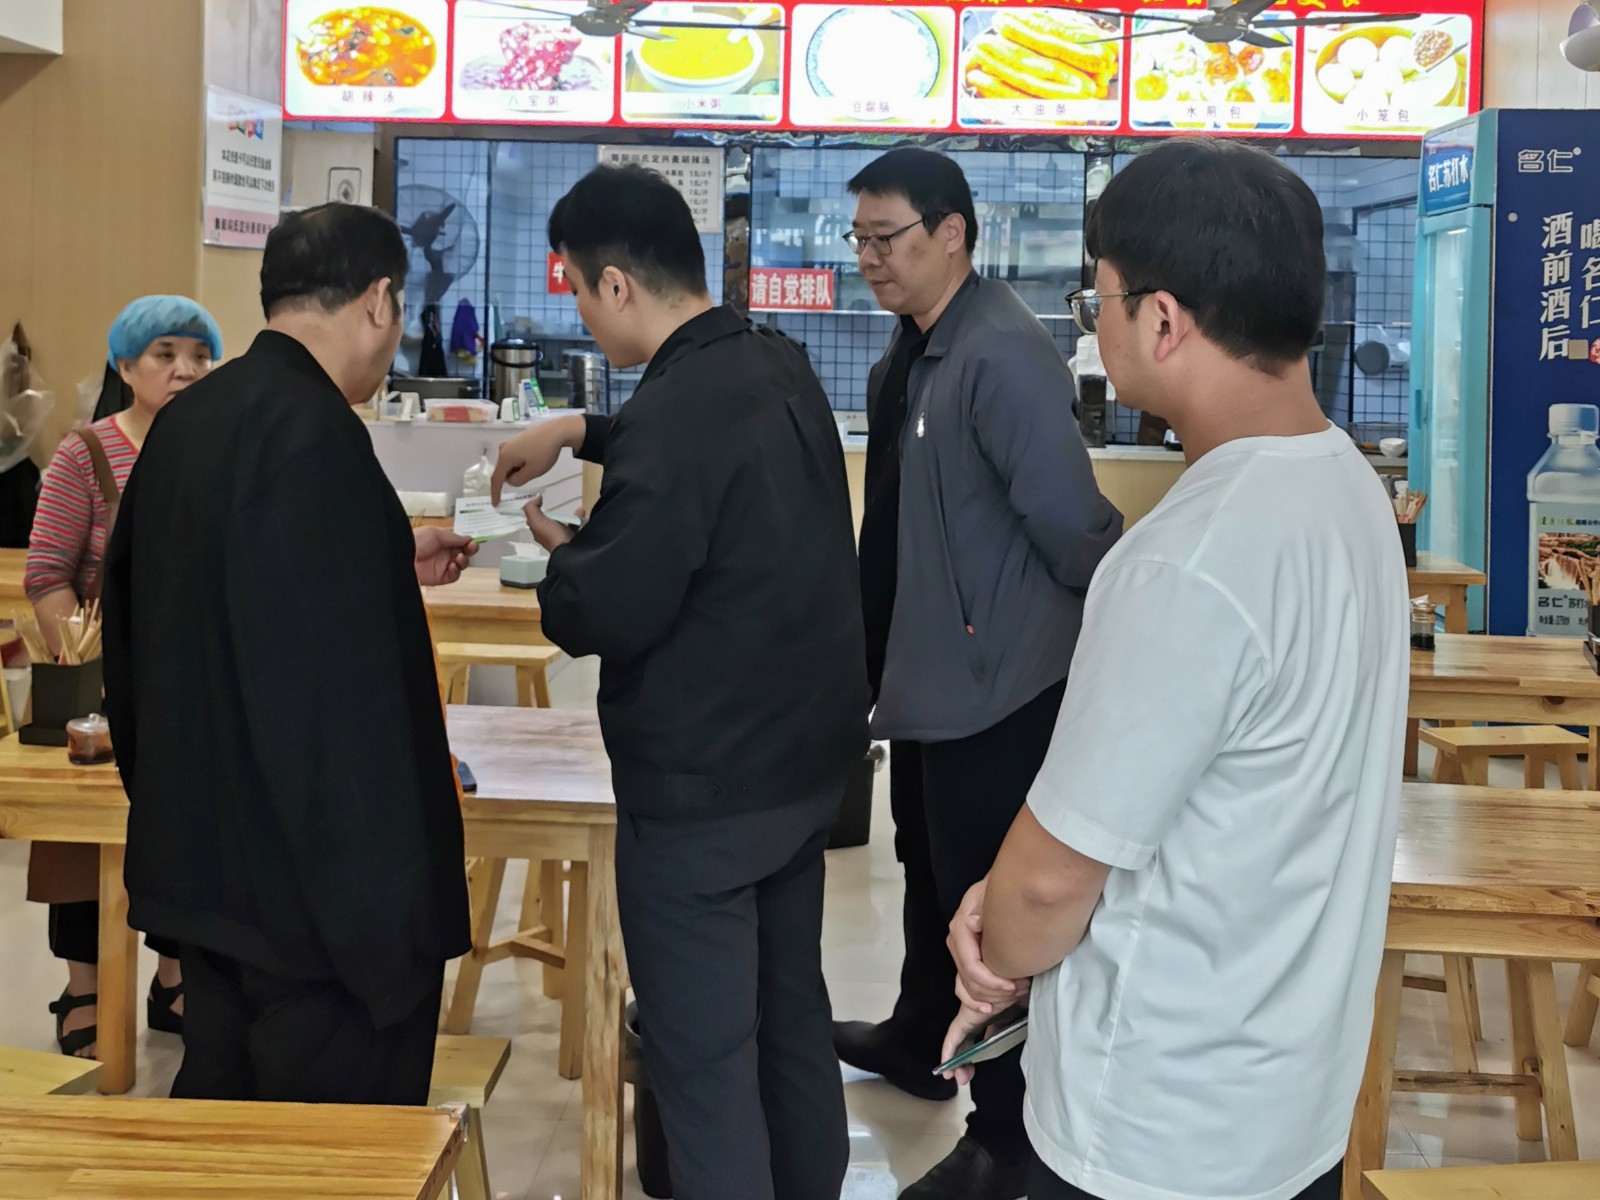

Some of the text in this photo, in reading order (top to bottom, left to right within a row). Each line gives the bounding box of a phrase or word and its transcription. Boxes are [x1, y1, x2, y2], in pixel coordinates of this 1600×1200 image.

[341, 92, 395, 105] 胡辣汤
[508, 94, 560, 108] 八宝粥
[683, 98, 722, 110] 小米粥
[1011, 103, 1067, 116] 大油条
[1185, 105, 1242, 119] 水煎包
[1356, 107, 1410, 123] 小笼包
[1518, 148, 1573, 173] 名仁
[1428, 154, 1468, 193] 名仁苏打水
[750, 271, 832, 306] 请自觉排队
[1539, 211, 1574, 361] 酒前酒后
